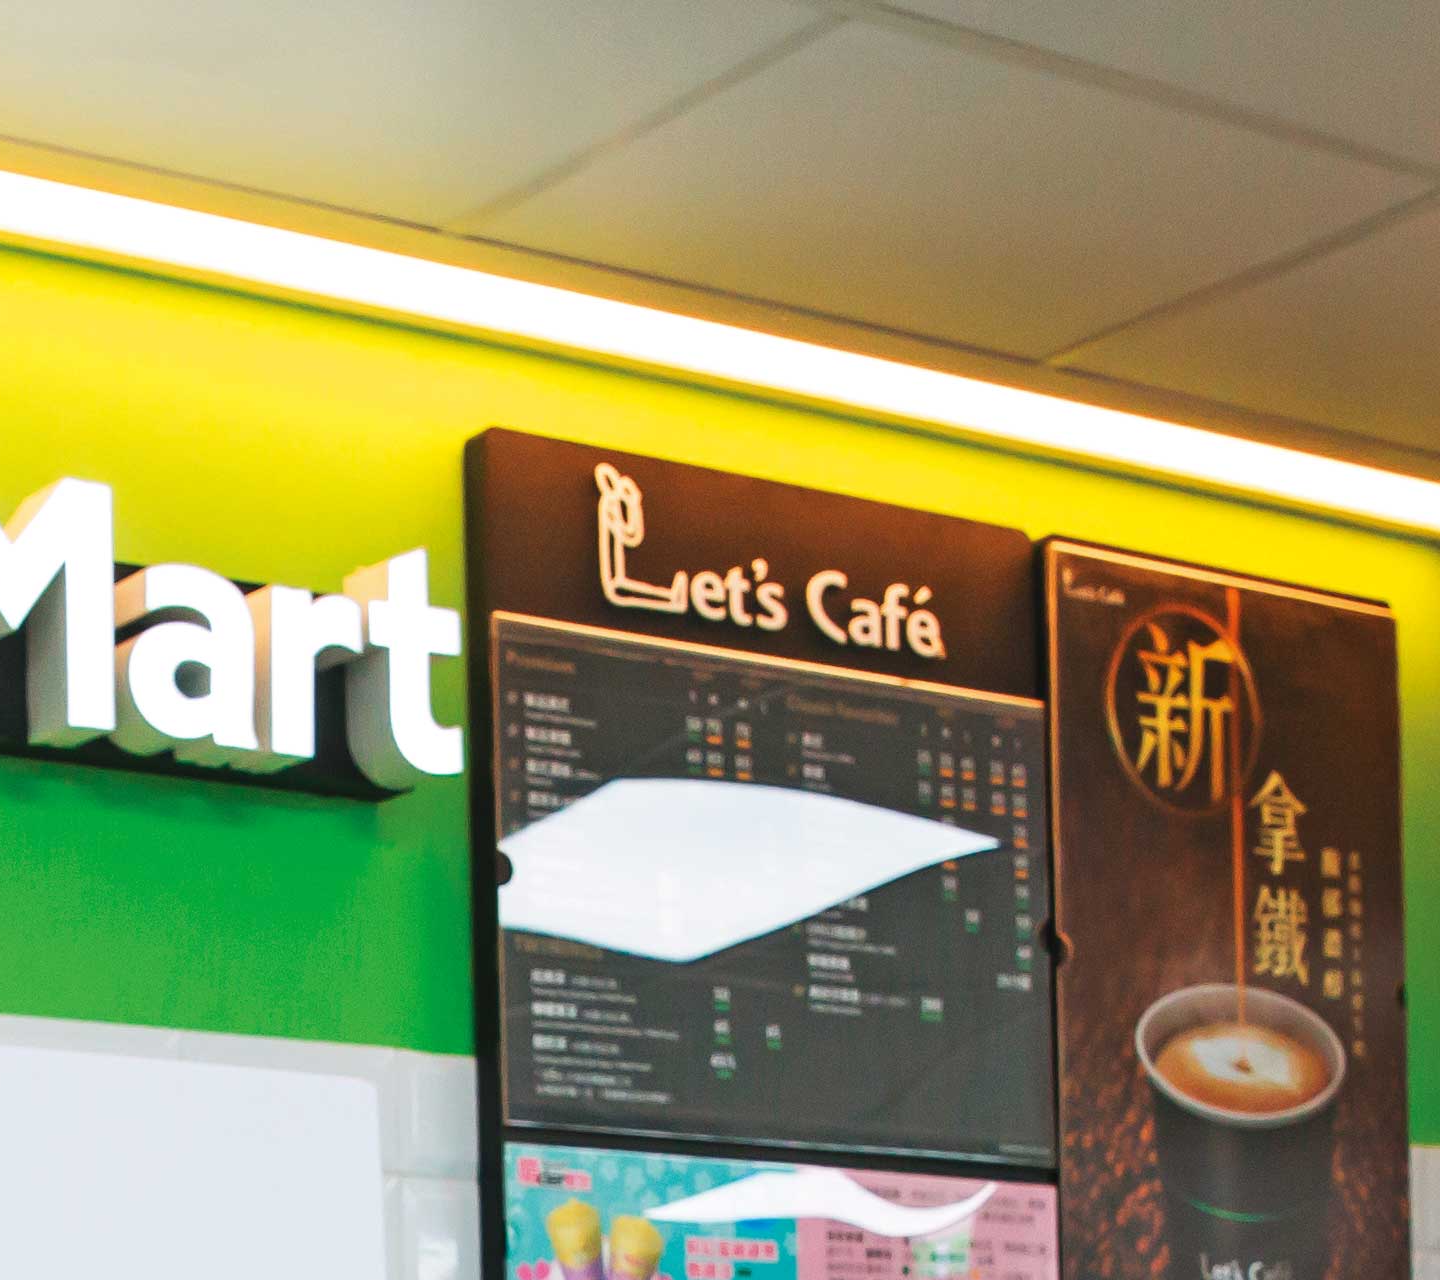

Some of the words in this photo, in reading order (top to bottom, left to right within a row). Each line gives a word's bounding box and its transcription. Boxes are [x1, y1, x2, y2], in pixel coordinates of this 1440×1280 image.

[594, 461, 788, 632] Let's
[807, 568, 946, 659] Café
[1136, 622, 1238, 800] 新
